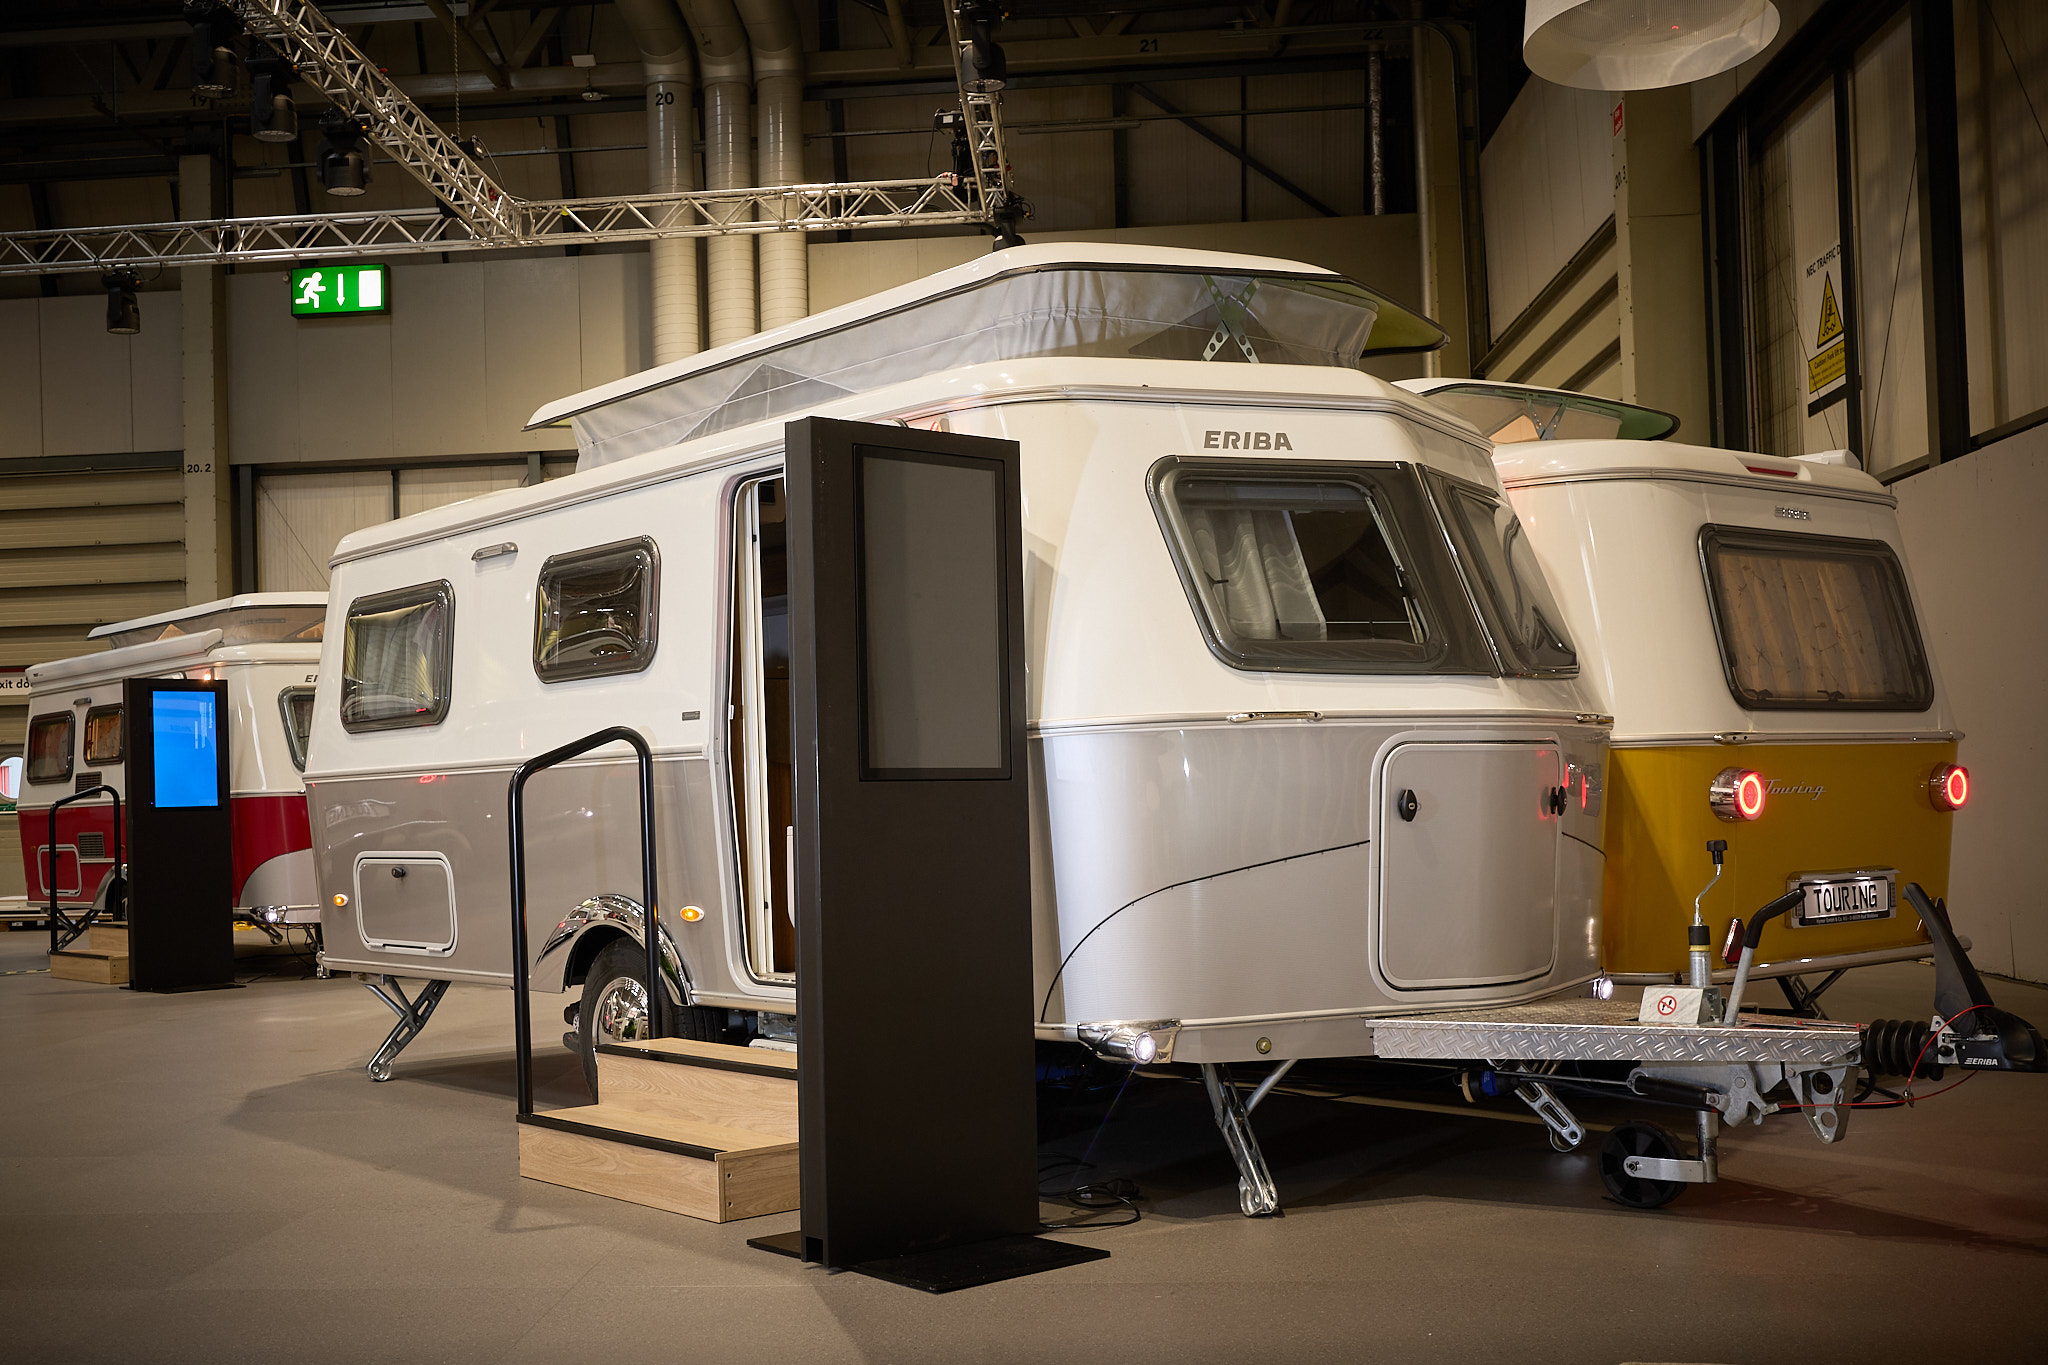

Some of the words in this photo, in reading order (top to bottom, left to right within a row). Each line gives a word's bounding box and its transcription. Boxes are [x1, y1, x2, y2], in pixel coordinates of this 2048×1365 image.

[1140, 39, 1158, 52] 21
[655, 92, 674, 106] 20
[1806, 262, 1816, 278] NEC
[1817, 246, 1836, 270] TRAFFIC
[1203, 430, 1293, 451] ERIBA
[187, 463, 212, 473] 20.2
[16, 678, 33, 689] do
[1765, 779, 1826, 801] Touring
[1813, 885, 1877, 913] TOURING
[1972, 1057, 1998, 1066] ERIBA
